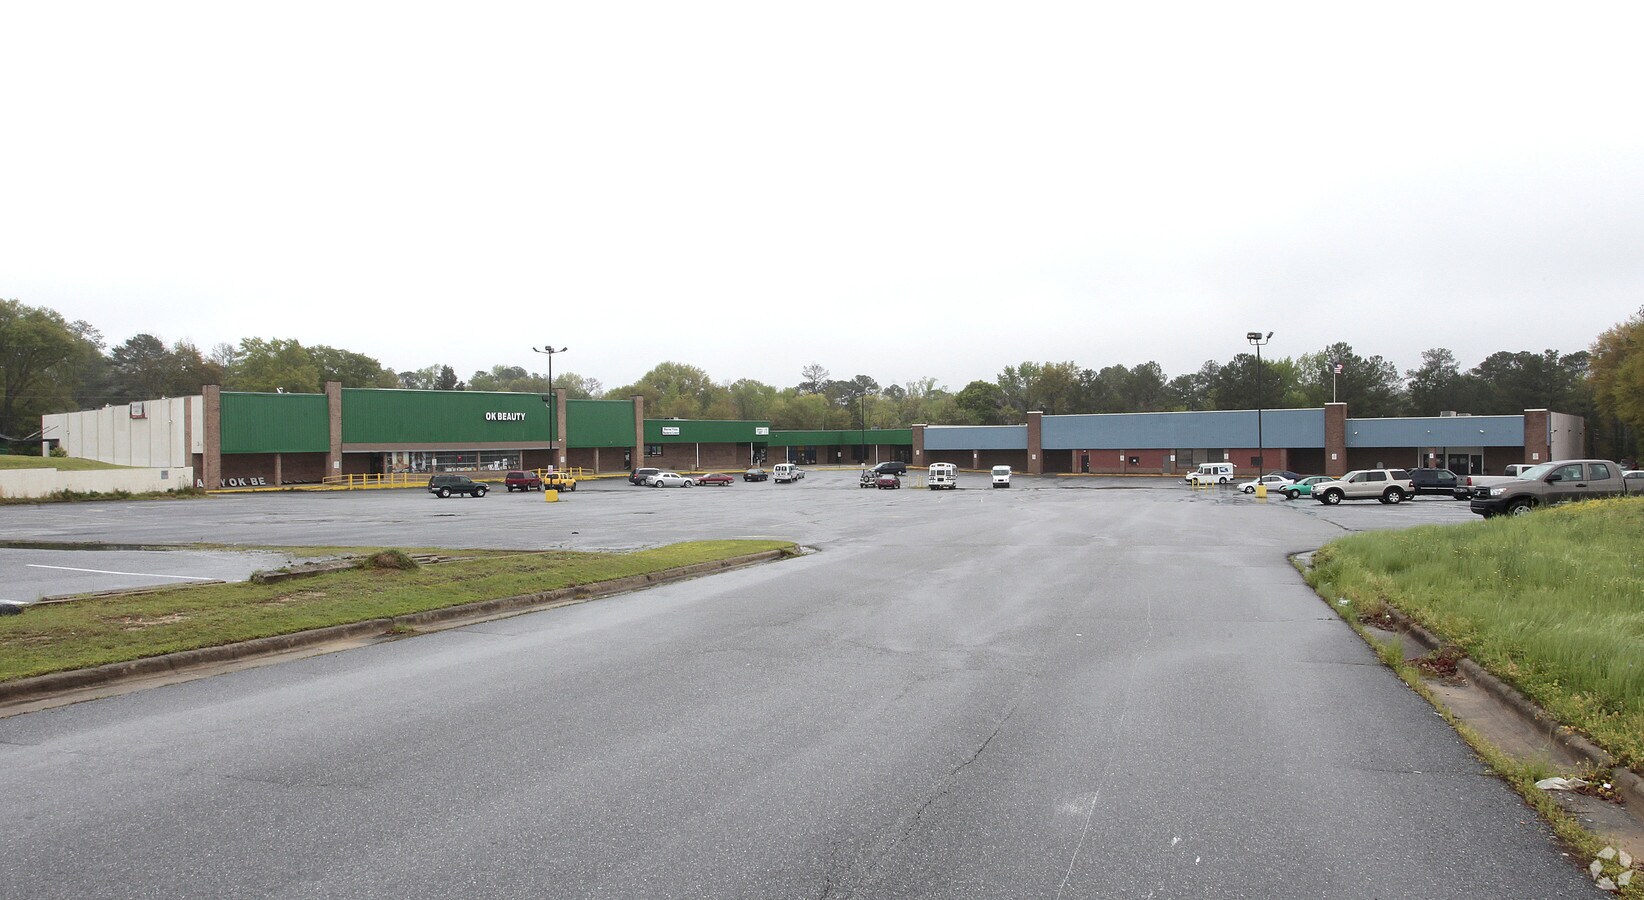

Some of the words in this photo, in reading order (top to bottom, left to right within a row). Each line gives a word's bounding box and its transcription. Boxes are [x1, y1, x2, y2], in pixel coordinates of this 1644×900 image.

[485, 412, 497, 420] OK
[497, 412, 526, 420] BEAUTY
[228, 478, 247, 487] OK
